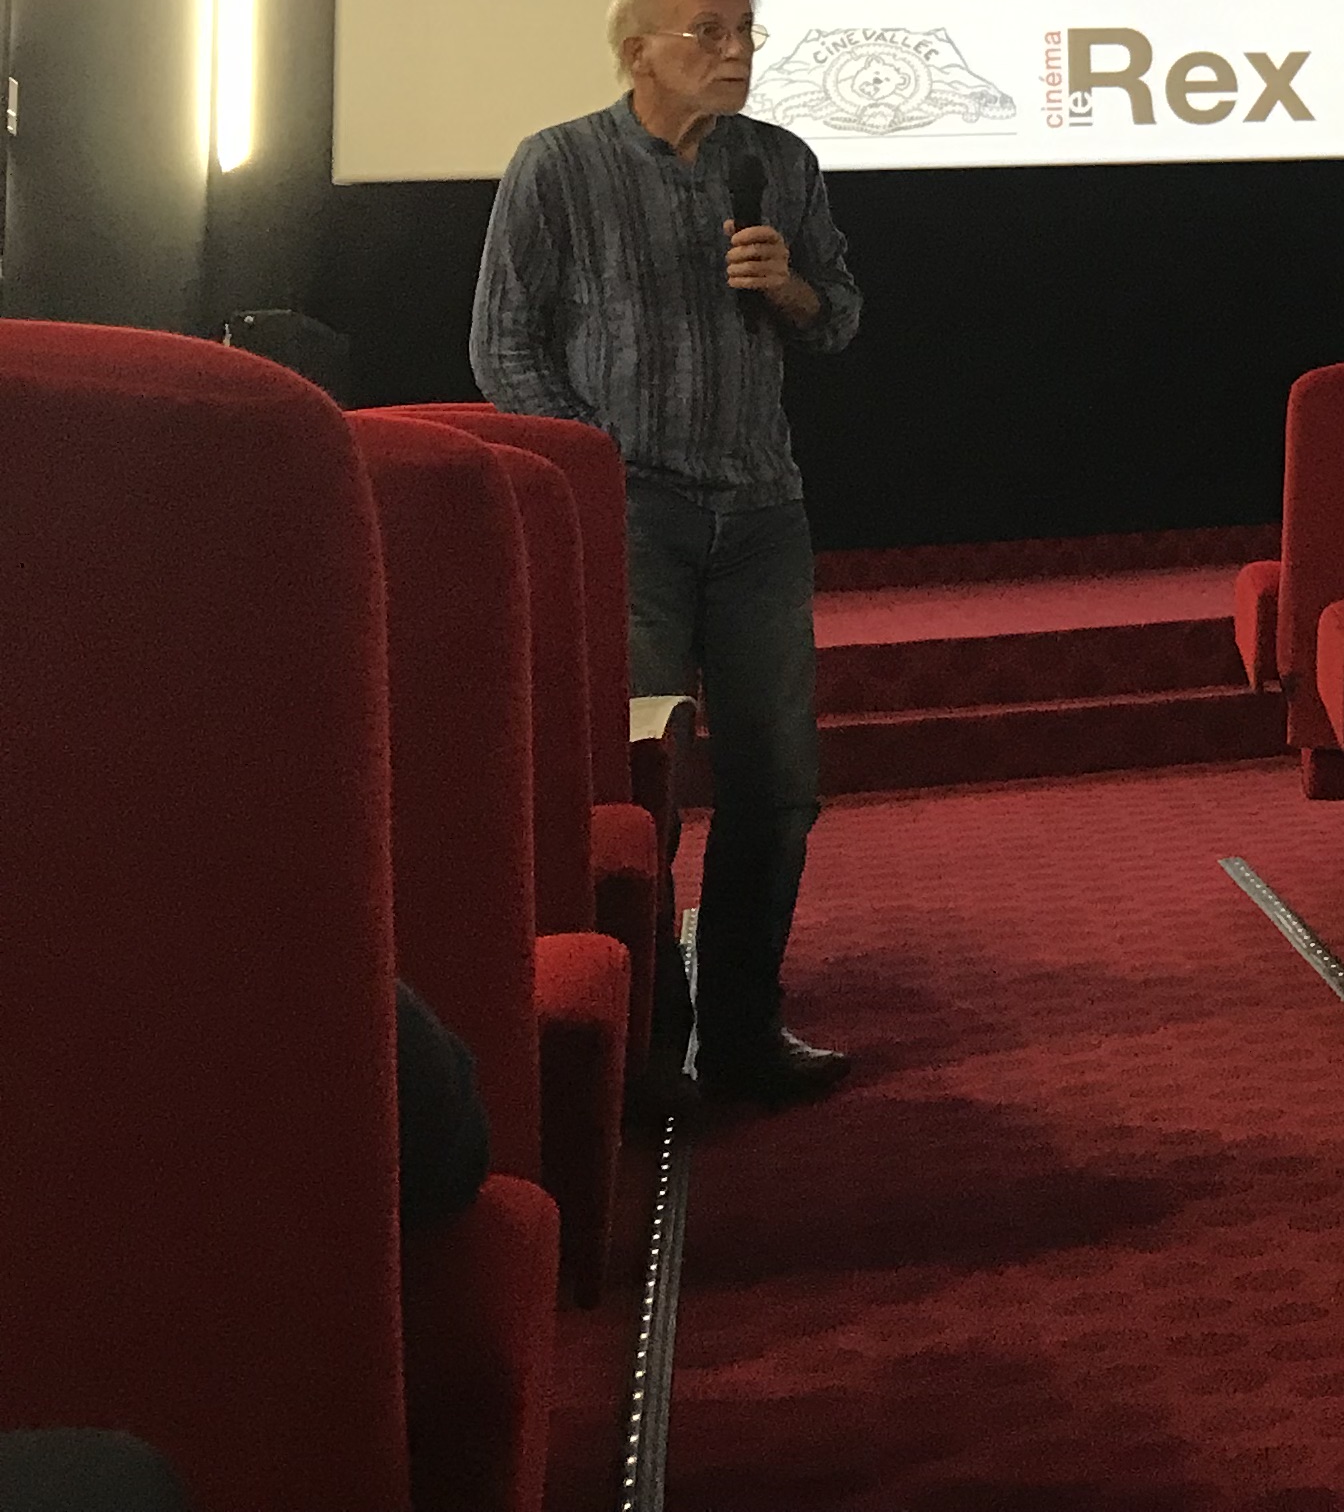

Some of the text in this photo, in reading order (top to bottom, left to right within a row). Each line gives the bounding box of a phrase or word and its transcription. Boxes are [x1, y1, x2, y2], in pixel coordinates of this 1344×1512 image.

[1039, 30, 1064, 129] cinéma
[1066, 25, 1317, 126] Rex
[1068, 90, 1094, 128] le
